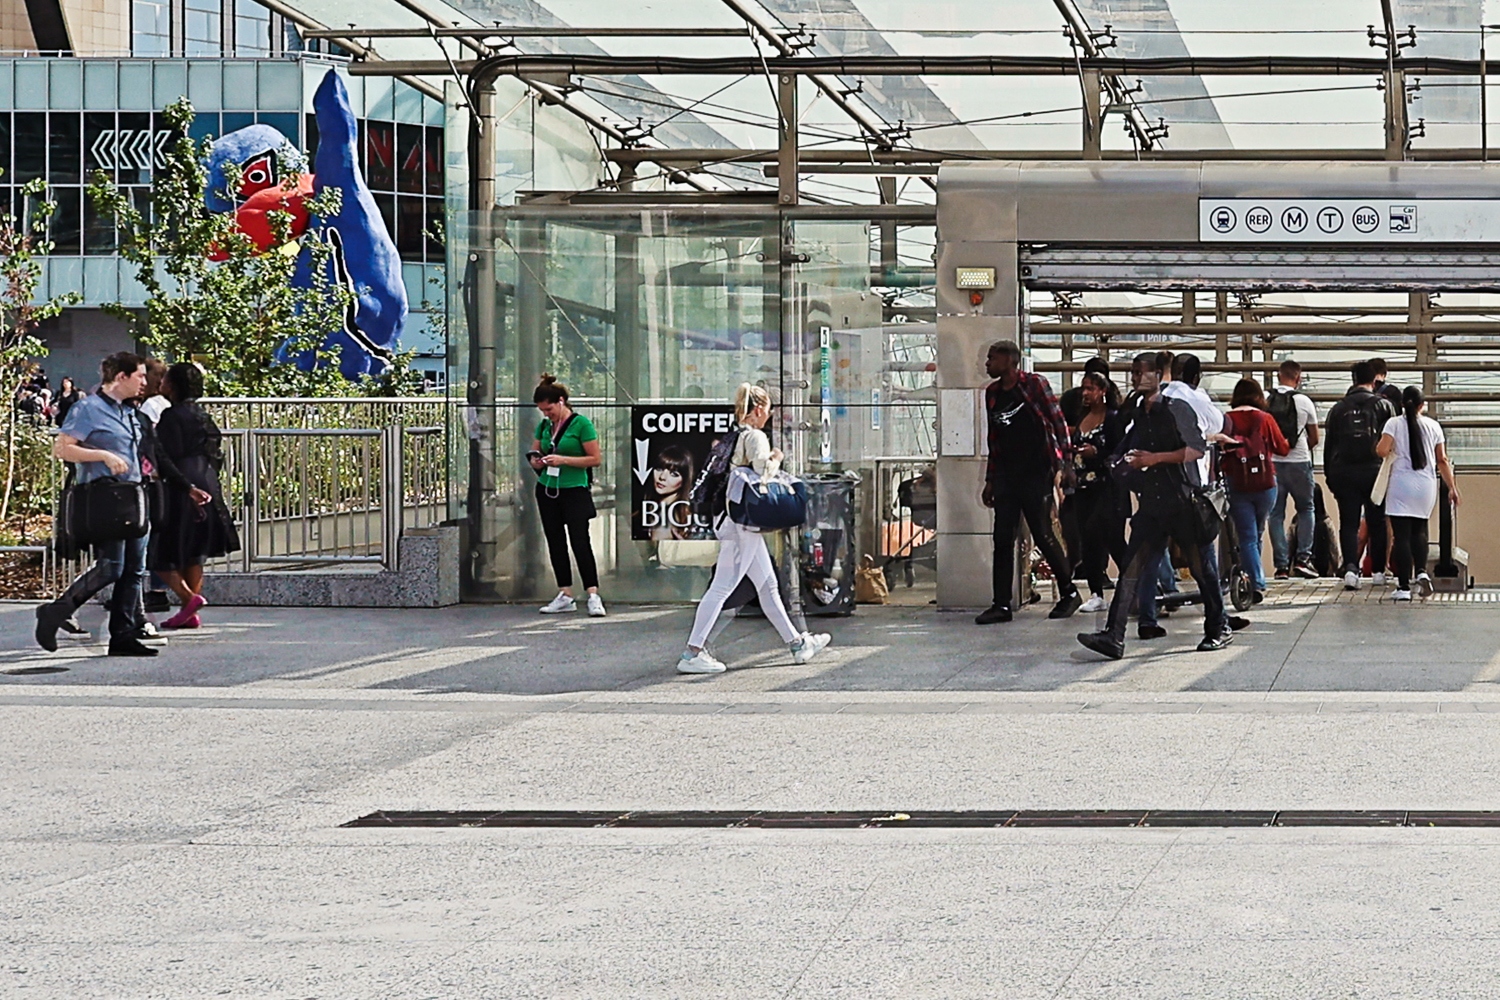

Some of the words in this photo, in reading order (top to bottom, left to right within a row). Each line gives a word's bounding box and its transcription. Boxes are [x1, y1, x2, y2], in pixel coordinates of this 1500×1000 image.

[1249, 214, 1269, 225] RER
[1287, 212, 1302, 228] M
[1323, 213, 1337, 228] T
[1356, 214, 1376, 225] BUS
